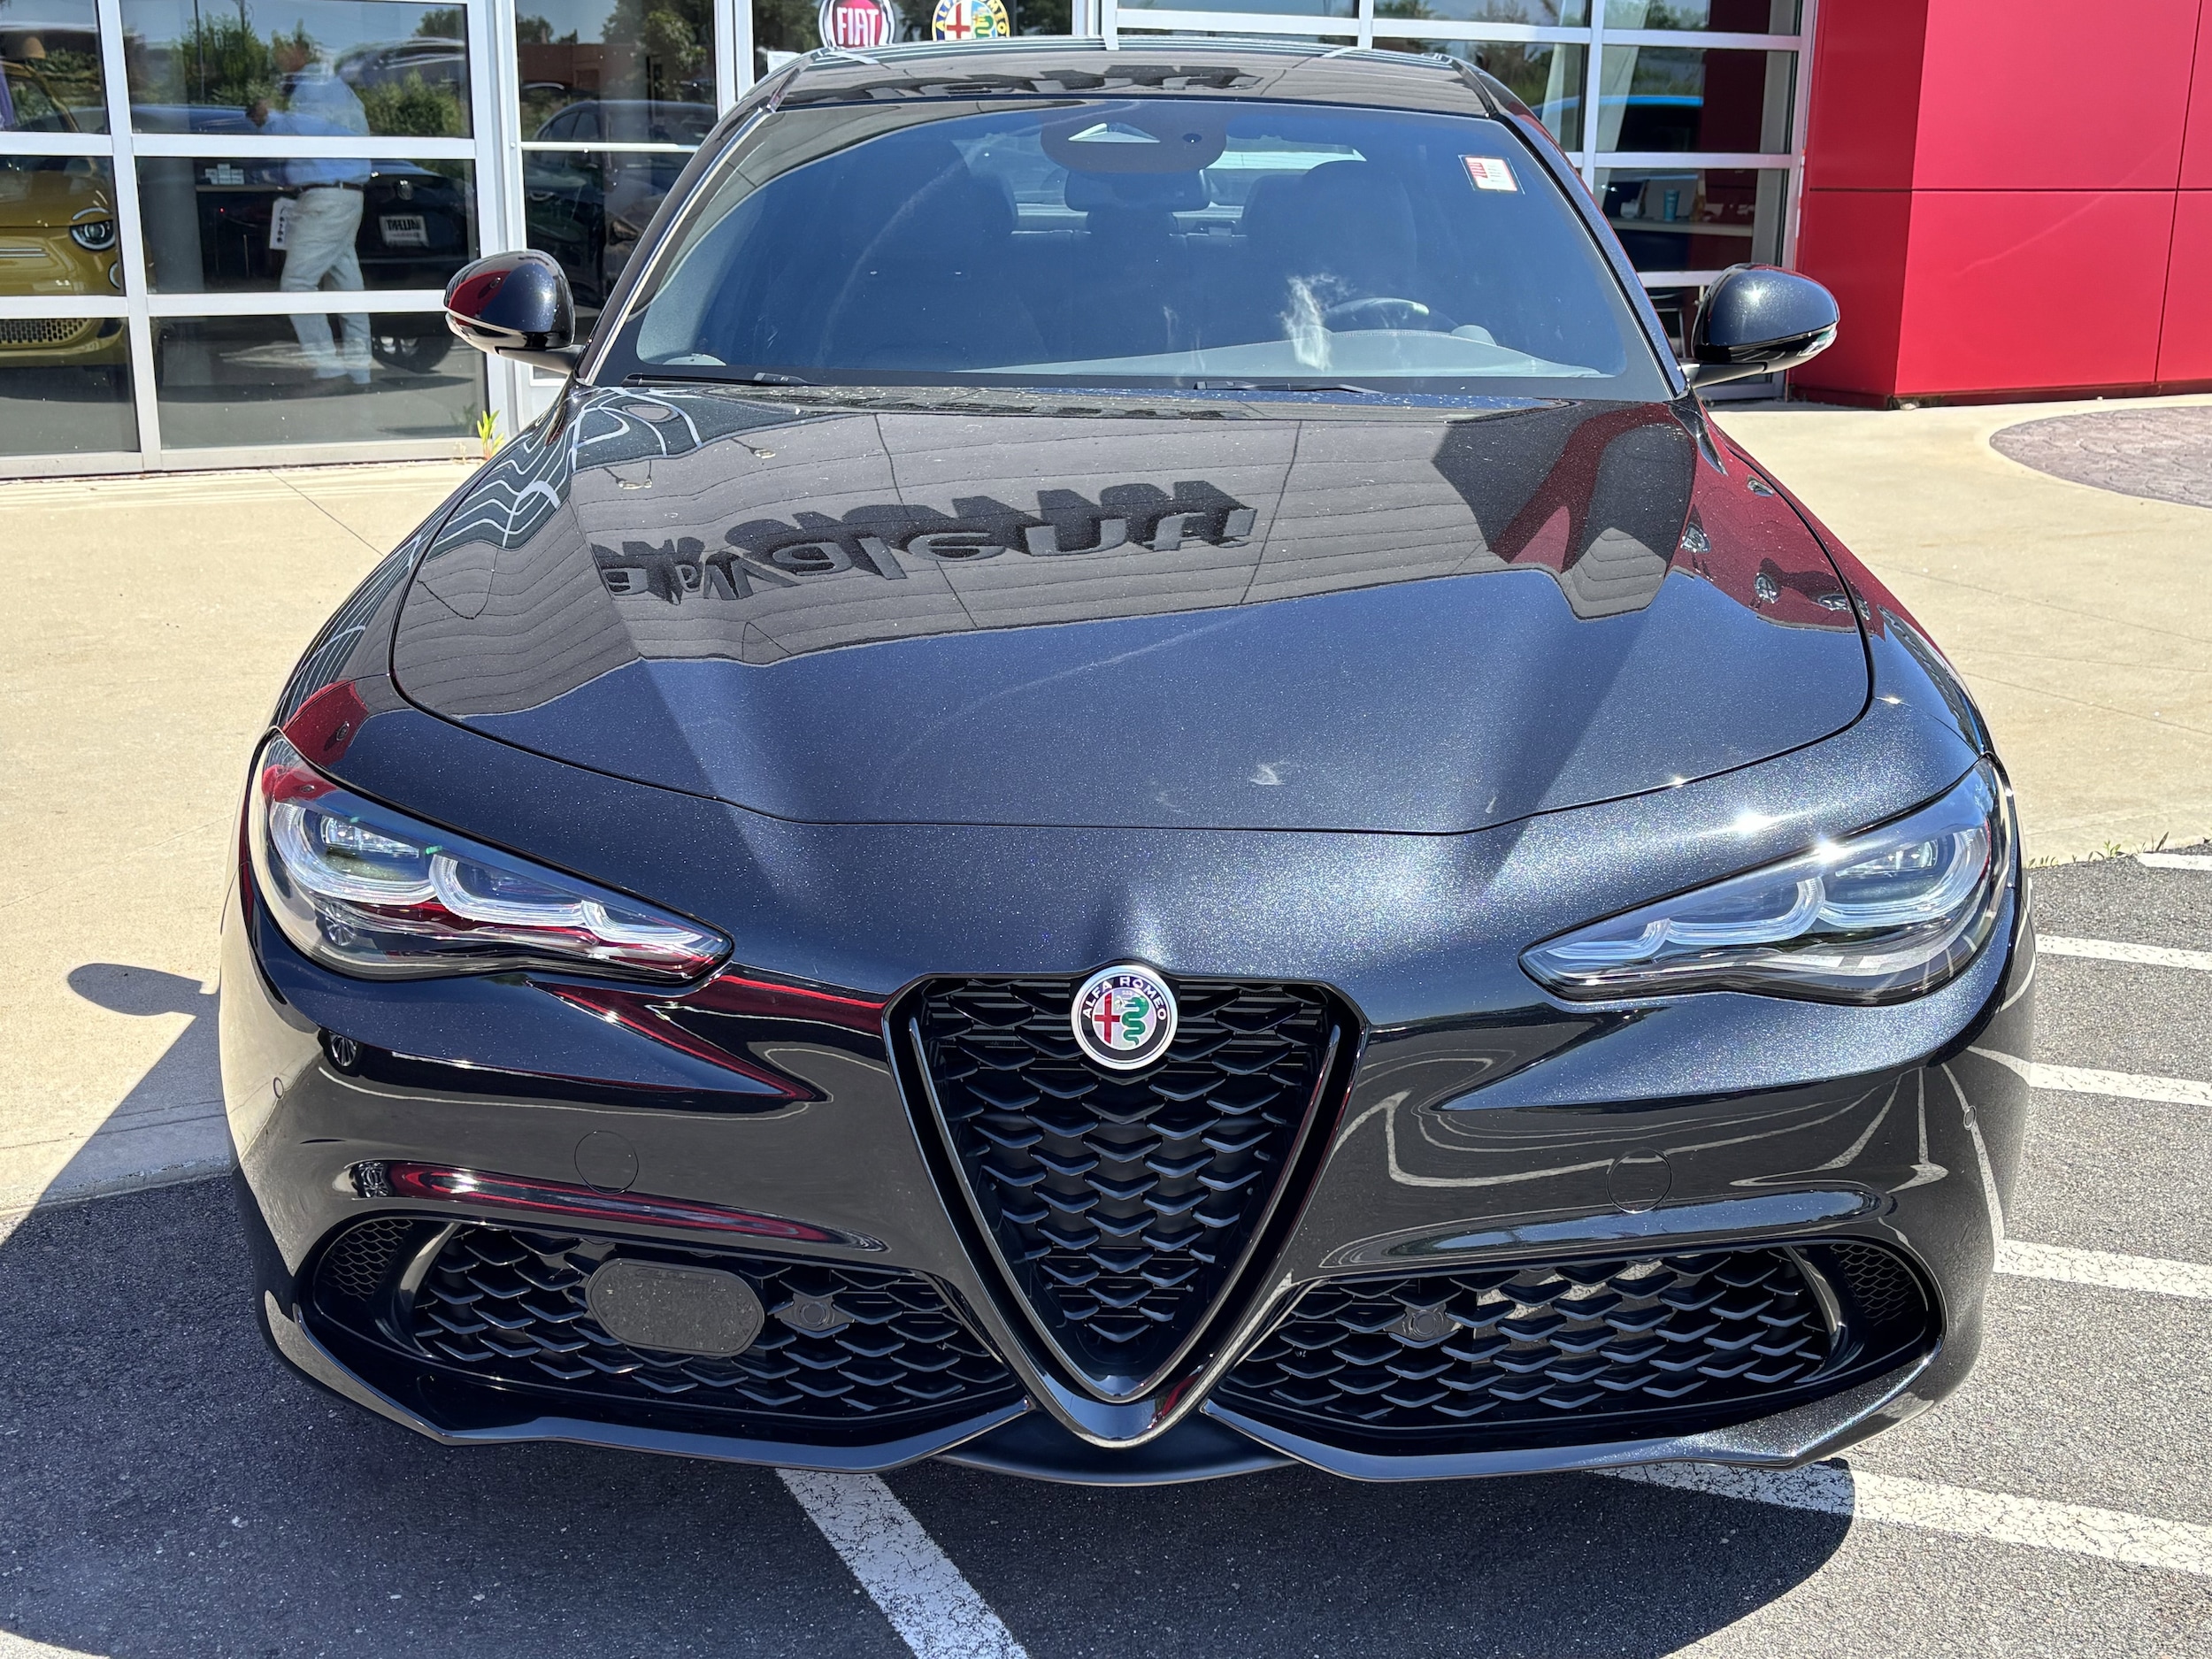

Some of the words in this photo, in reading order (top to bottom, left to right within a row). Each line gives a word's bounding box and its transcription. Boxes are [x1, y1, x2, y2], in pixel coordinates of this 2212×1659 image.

[837, 7, 879, 47] FIAT
[1082, 980, 1113, 1018] ALFA
[1119, 976, 1167, 1020] ROMEO
